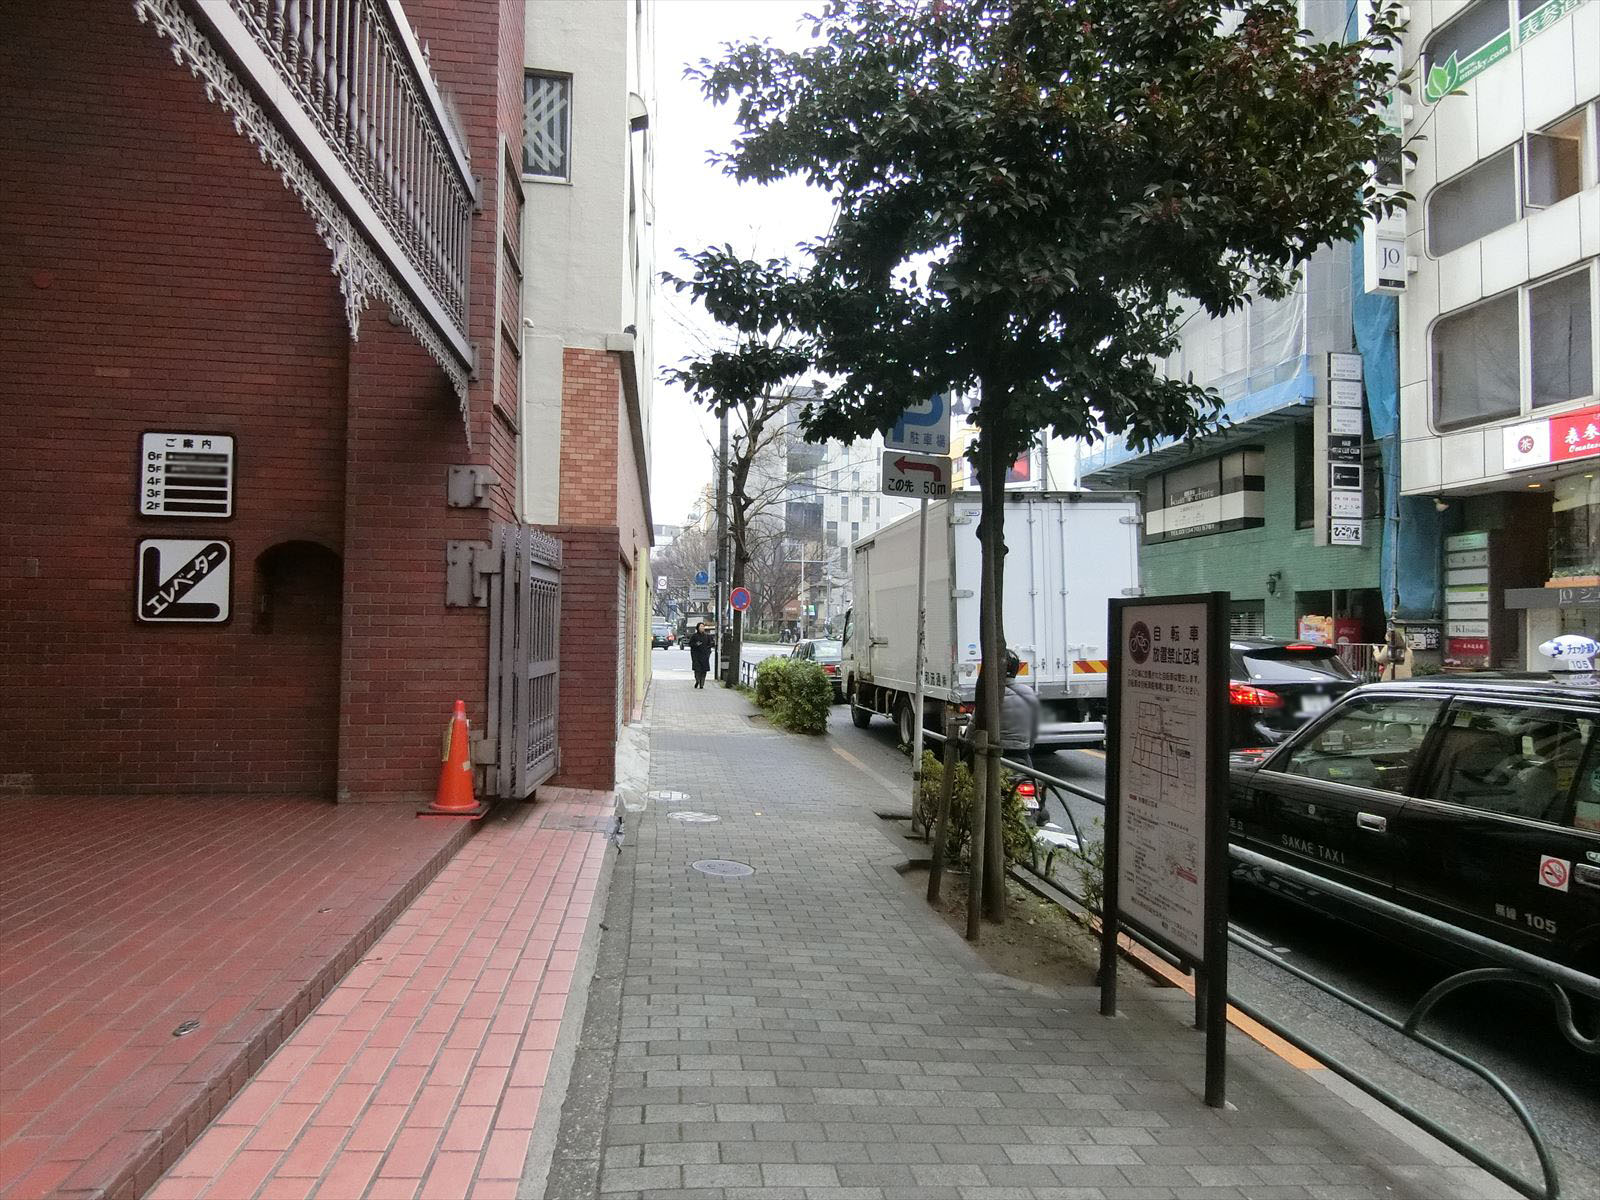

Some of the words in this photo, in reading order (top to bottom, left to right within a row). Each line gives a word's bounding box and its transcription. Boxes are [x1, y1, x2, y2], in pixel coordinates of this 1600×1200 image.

[1382, 247, 1400, 270] JO
[165, 438, 212, 450] ご案内
[910, 431, 946, 448] 駐車場
[147, 452, 162, 460] 6F
[147, 464, 162, 473] 5F
[147, 477, 161, 486] 4F
[887, 478, 915, 493] この先
[923, 481, 946, 495] 50m
[146, 489, 161, 498] 3F
[146, 501, 160, 510] 2F
[146, 551, 219, 615] エレベーター
[1153, 625, 1199, 642] 自転車
[1153, 647, 1199, 666] 放置禁止区域
[1570, 660, 1589, 670] 105
[1281, 834, 1314, 856] SAKAE
[1318, 845, 1345, 864] TAXI
[1524, 913, 1557, 934] 105
